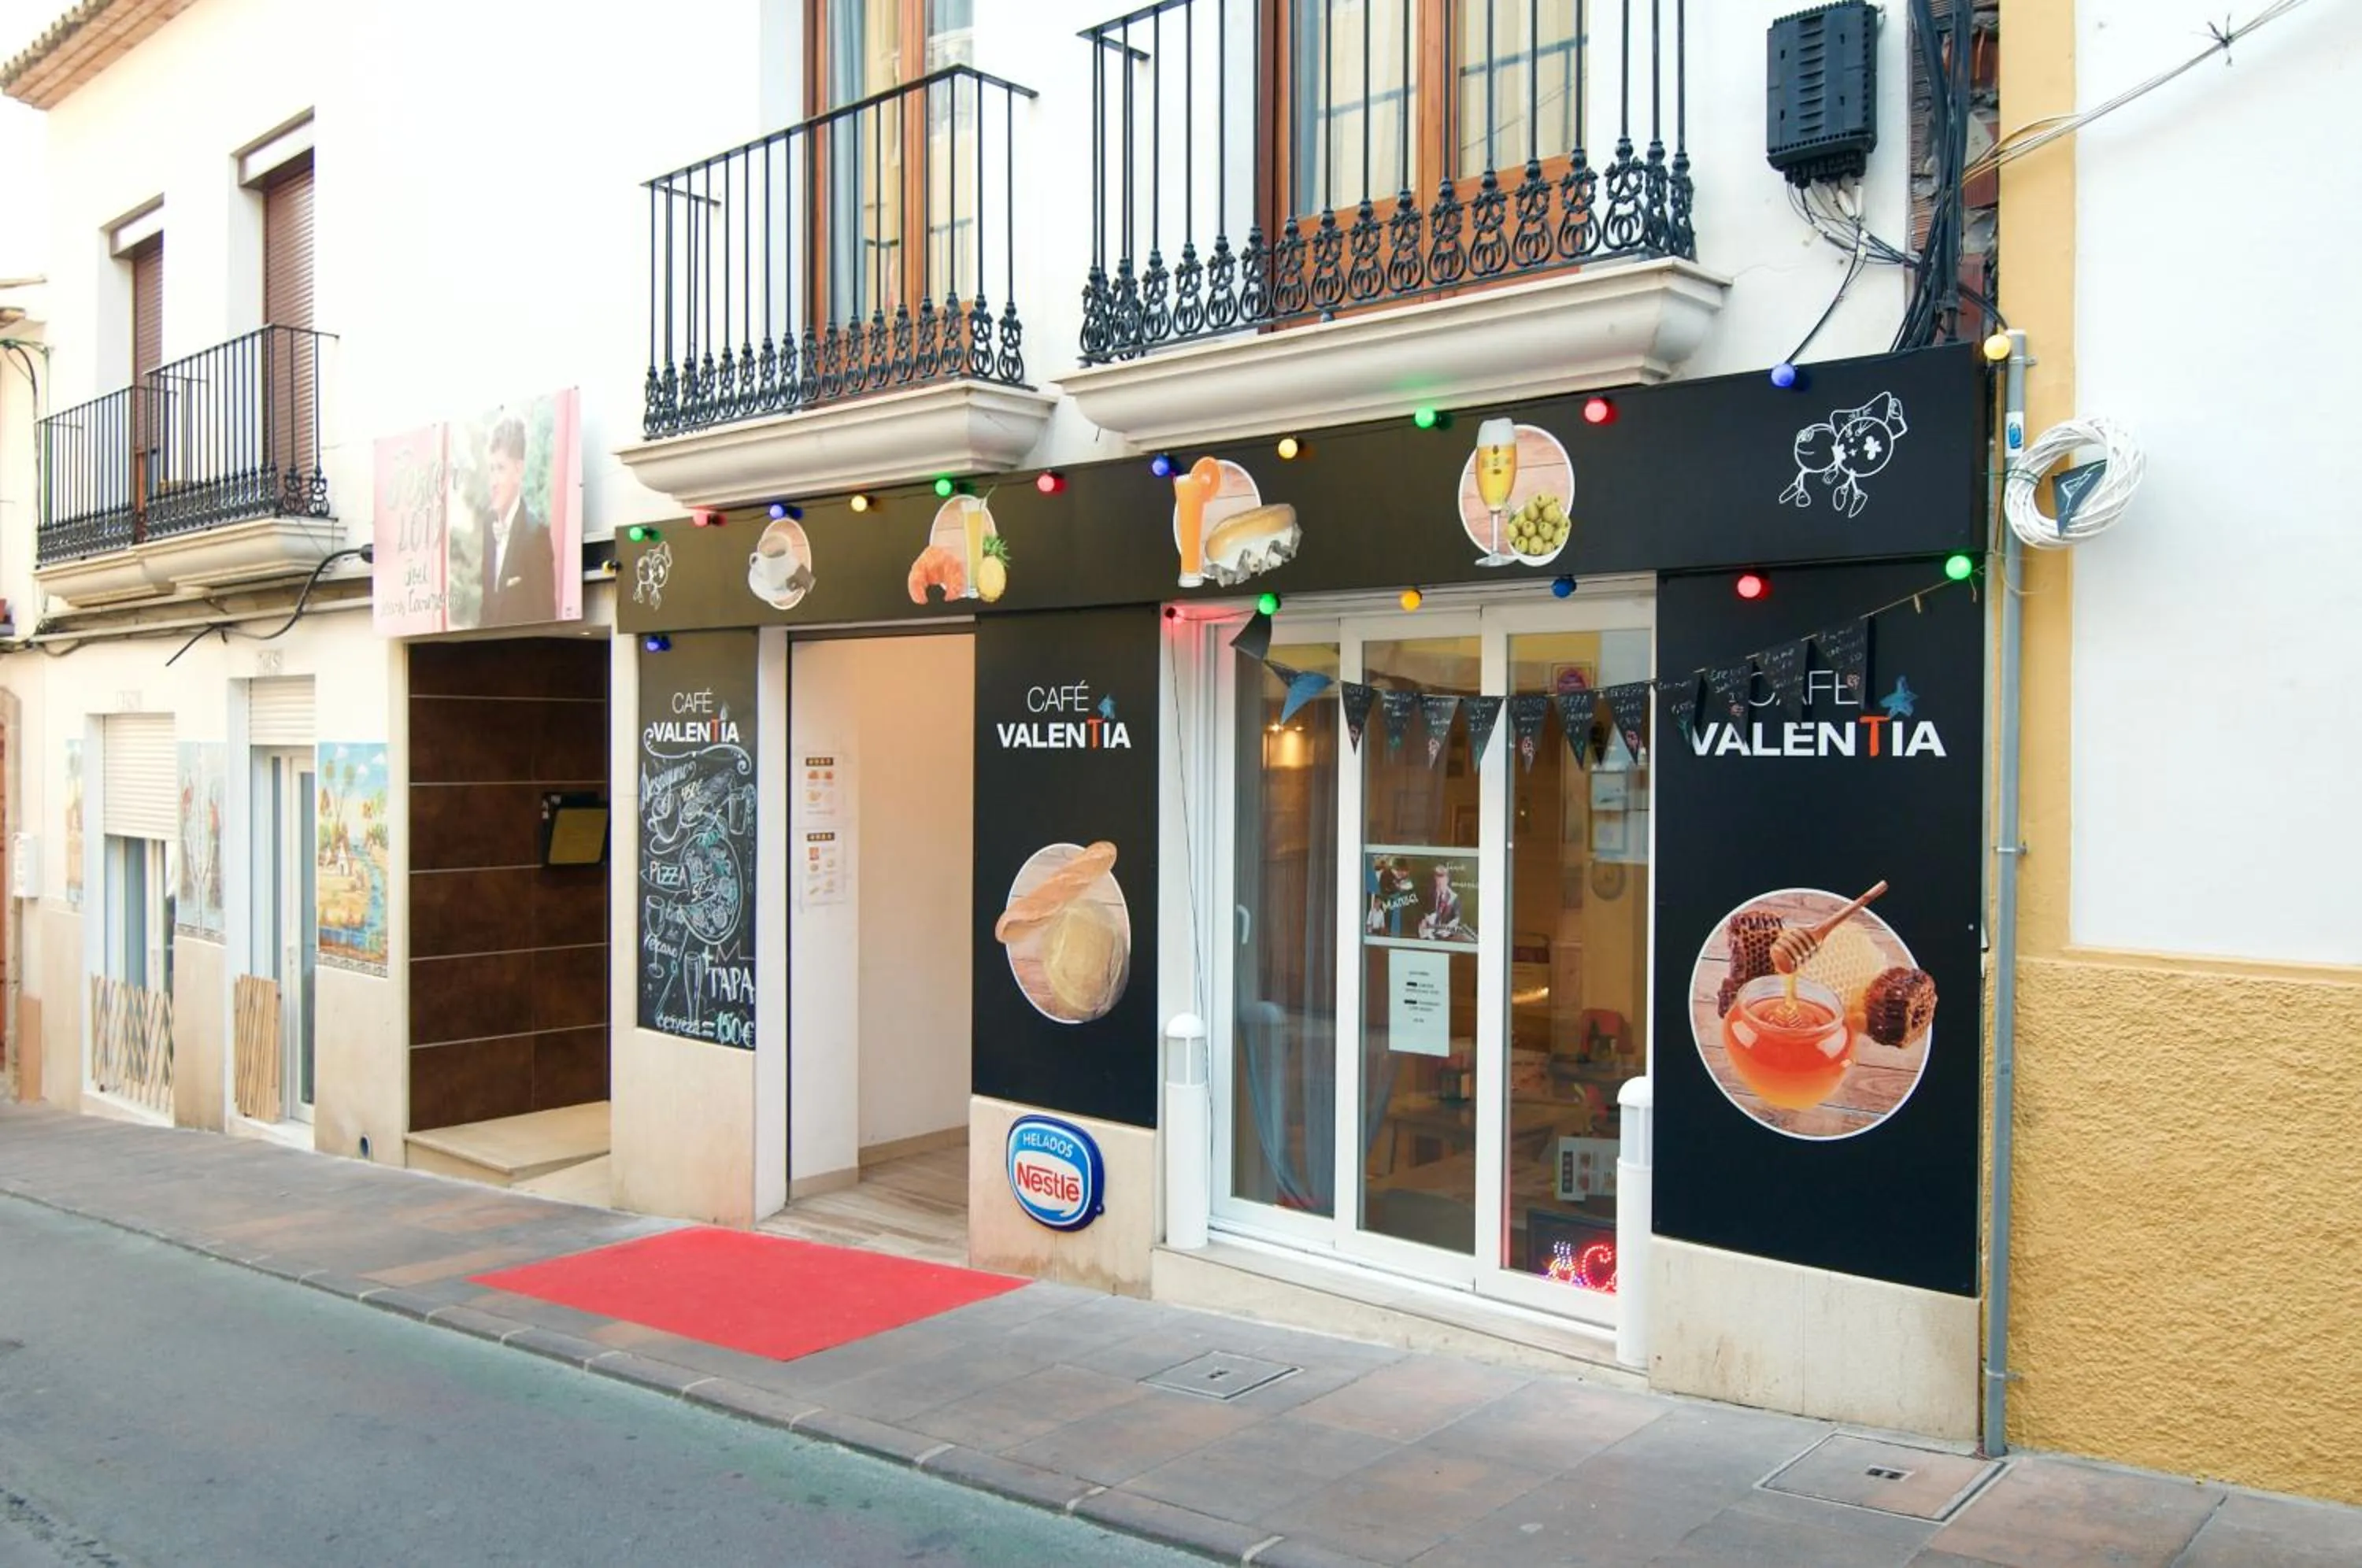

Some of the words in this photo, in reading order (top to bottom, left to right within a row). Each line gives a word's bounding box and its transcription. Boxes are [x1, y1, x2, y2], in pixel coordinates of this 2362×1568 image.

[672, 687, 713, 714] CAFÉ
[1027, 680, 1090, 713] CAFÉ
[653, 716, 740, 743] VALENTIA
[996, 718, 1131, 749] VALENTIA
[1692, 716, 1947, 757] VALENTIA
[708, 967, 755, 1004] TAPA
[1023, 1133, 1074, 1158] HELADOS
